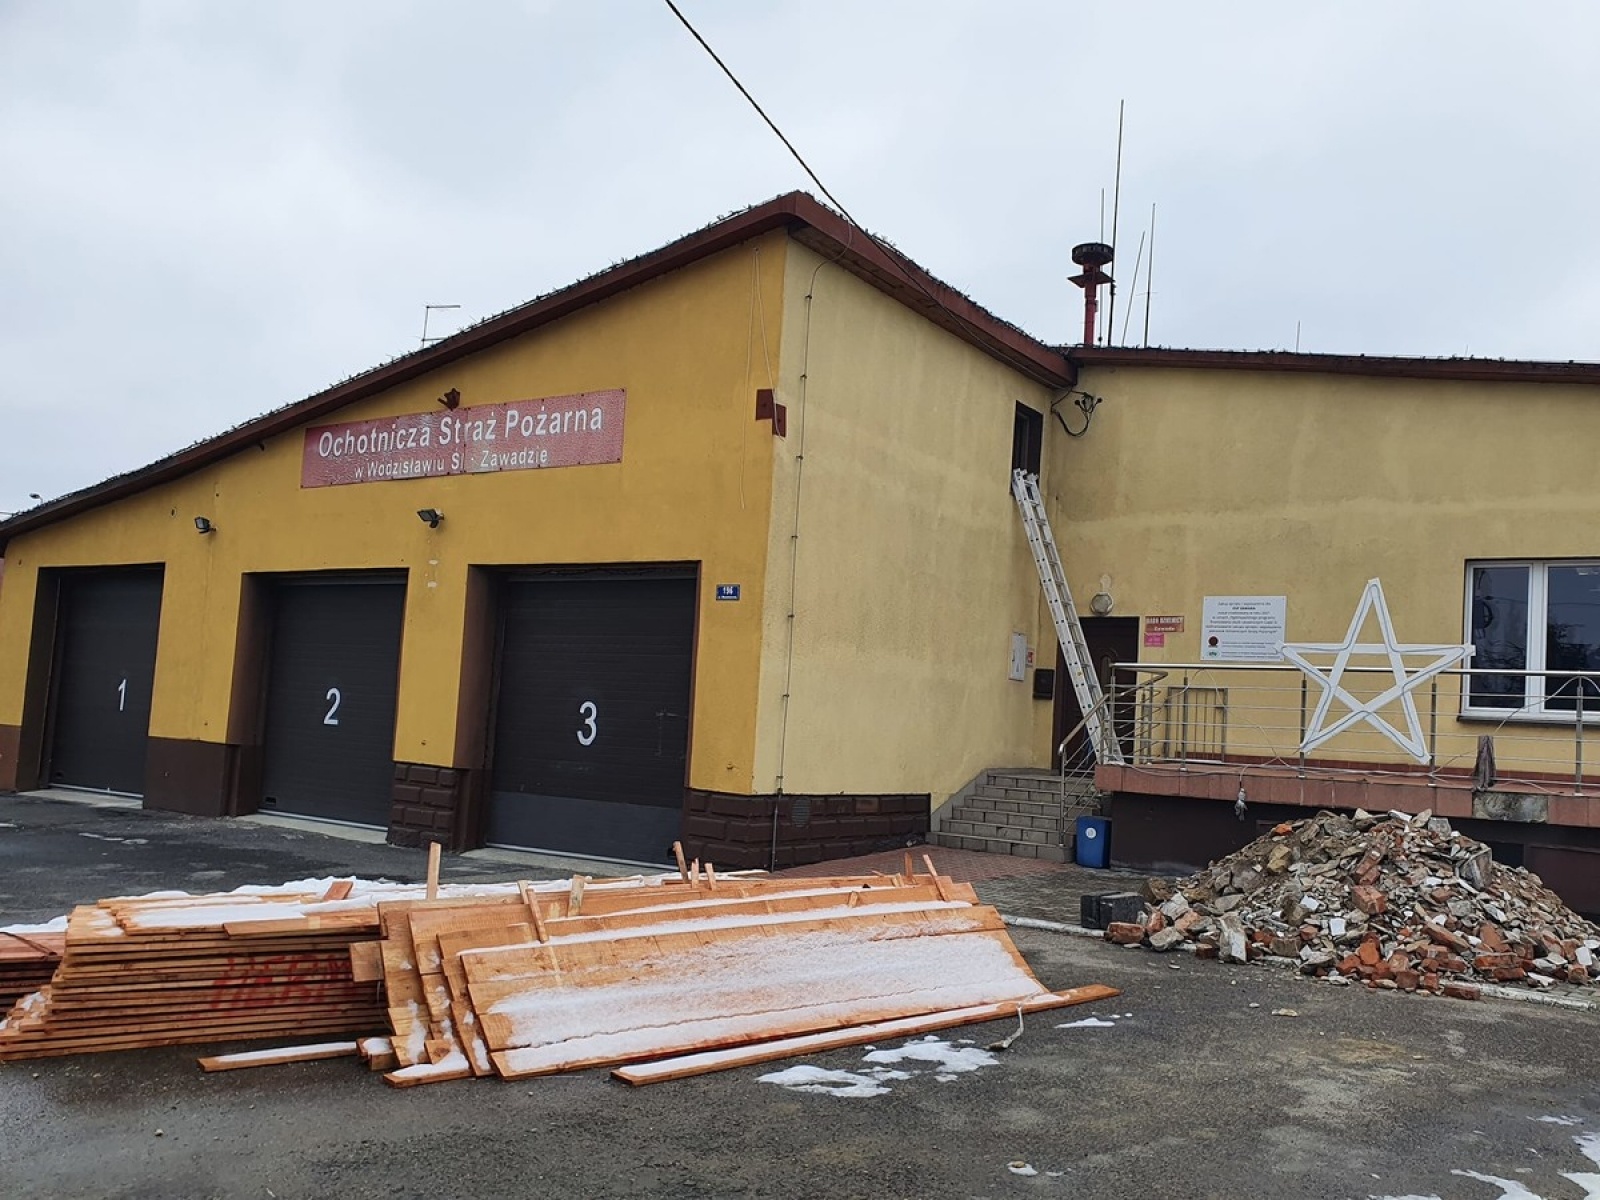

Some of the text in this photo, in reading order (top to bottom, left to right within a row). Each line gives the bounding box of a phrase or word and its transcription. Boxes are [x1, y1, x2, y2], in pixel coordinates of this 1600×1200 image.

[318, 406, 603, 458] Ochotnicza Straż Pożarna
[354, 466, 365, 479] w
[366, 458, 445, 478] Wodzisławiu
[480, 445, 549, 469] Zawadzie
[118, 679, 127, 712] 1
[324, 688, 341, 726] 2
[576, 701, 598, 746] 3
